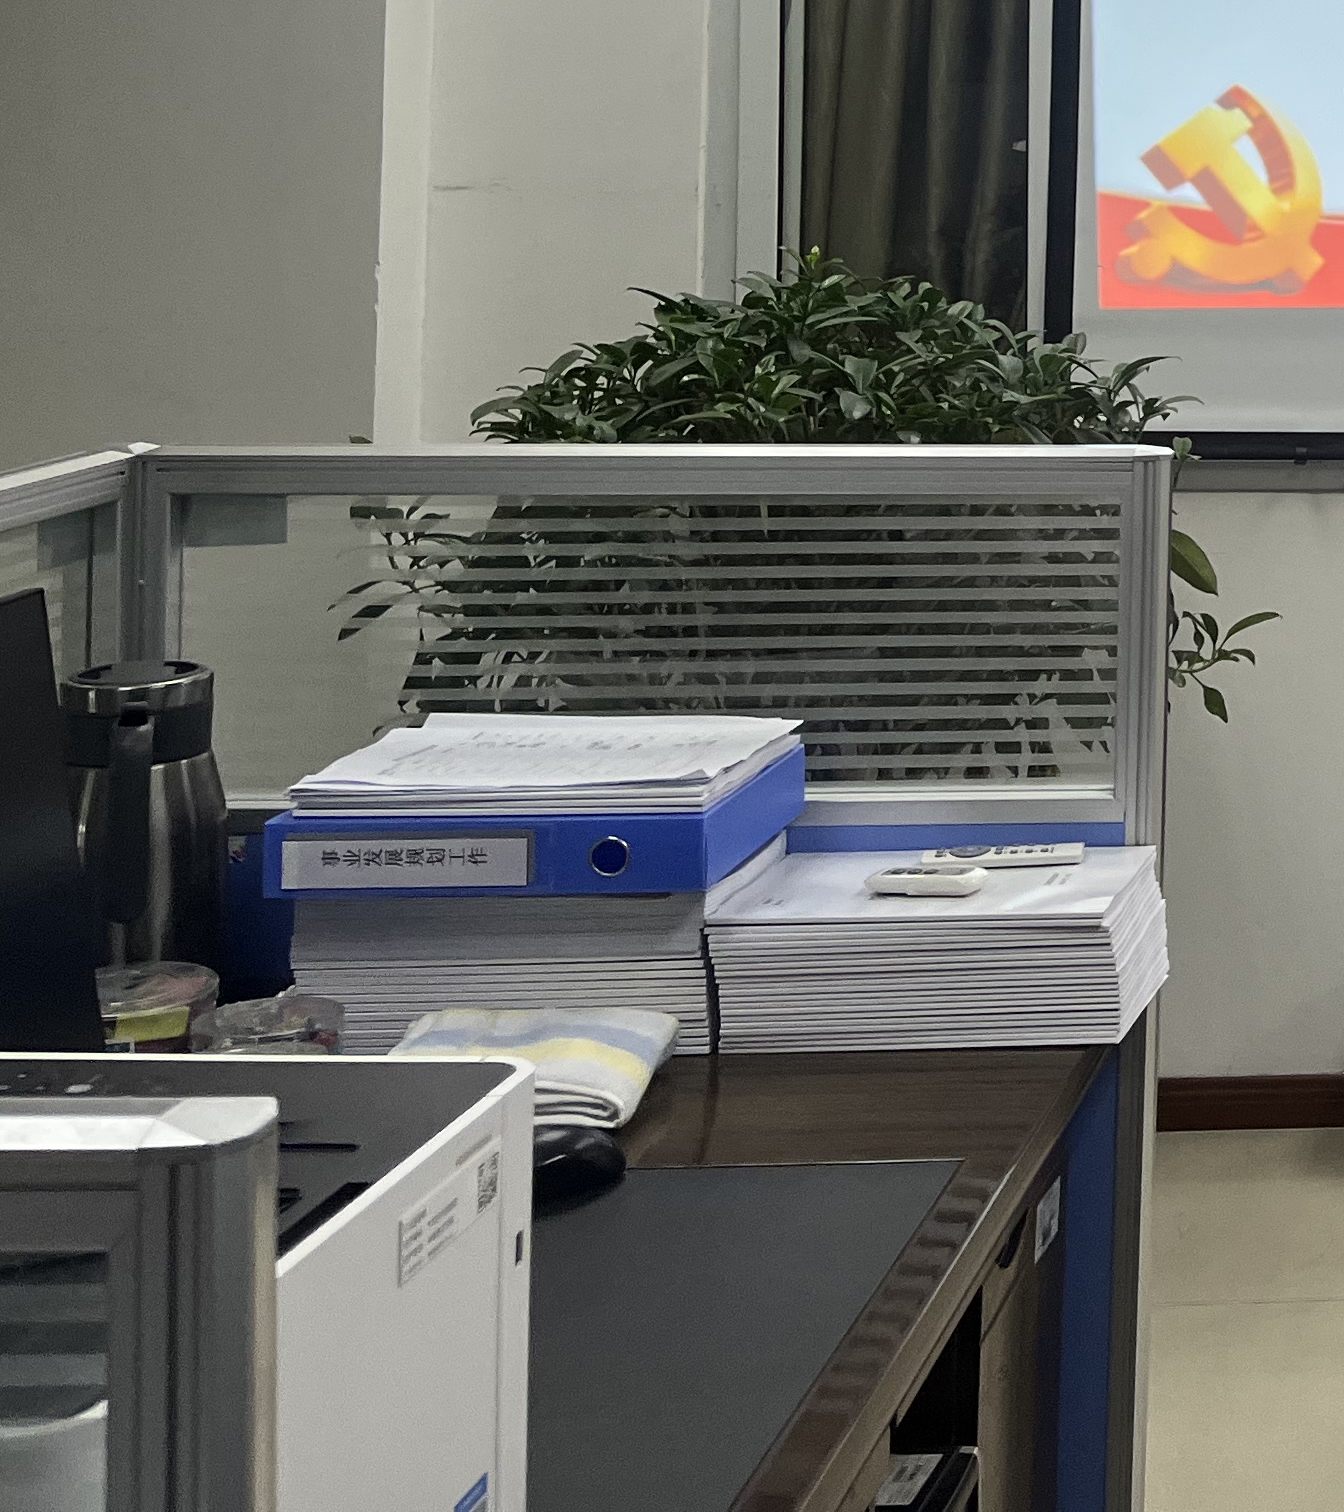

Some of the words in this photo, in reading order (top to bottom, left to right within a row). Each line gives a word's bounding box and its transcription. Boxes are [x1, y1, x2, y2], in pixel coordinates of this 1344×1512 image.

[321, 847, 488, 868] 事业发展规划工作
